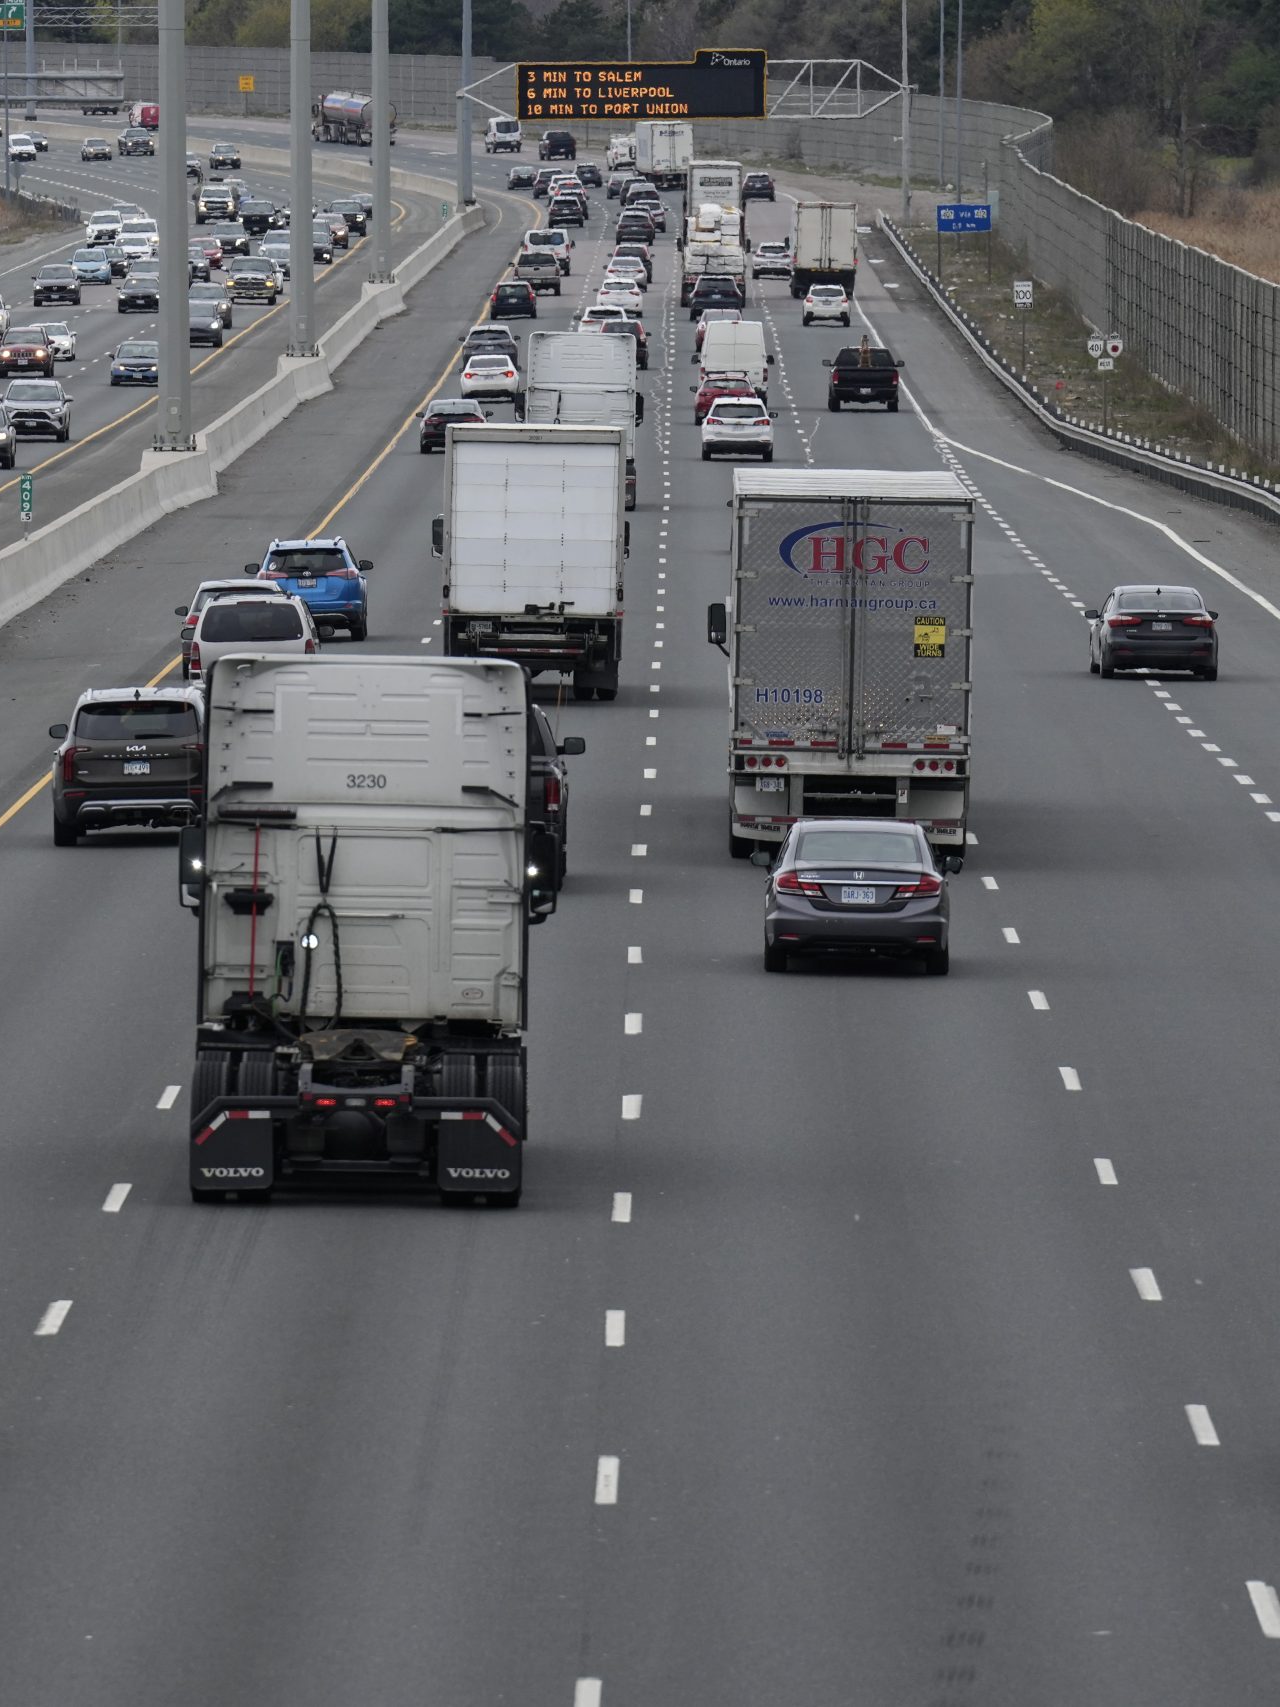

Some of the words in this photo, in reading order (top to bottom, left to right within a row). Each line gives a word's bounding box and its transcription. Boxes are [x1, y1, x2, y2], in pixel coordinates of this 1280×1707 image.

[723, 58, 751, 66] Ontario
[527, 71, 536, 83] 3
[543, 71, 567, 83] MIN
[574, 71, 592, 83] TO
[598, 71, 642, 83] SALEM
[527, 88, 536, 99] 6
[543, 88, 567, 99] MIN
[574, 88, 592, 99] TO
[598, 87, 675, 98] LIVERPOOL
[527, 104, 542, 115] 10
[550, 104, 573, 115] MIN
[581, 104, 598, 115] TO
[605, 103, 640, 115] PORT
[646, 103, 689, 114] UNION
[1016, 290, 1032, 300] 100
[1089, 343, 1102, 352] 401
[807, 536, 930, 574] HGC
[890, 580, 931, 588] GROUP
[769, 595, 937, 611] www.harmangroup.ca
[916, 617, 945, 625] CAUTION
[755, 687, 824, 704] H10198
[346, 774, 387, 789] 3230
[200, 1167, 265, 1178] VOLVO
[446, 1167, 511, 1179] VOLVO
